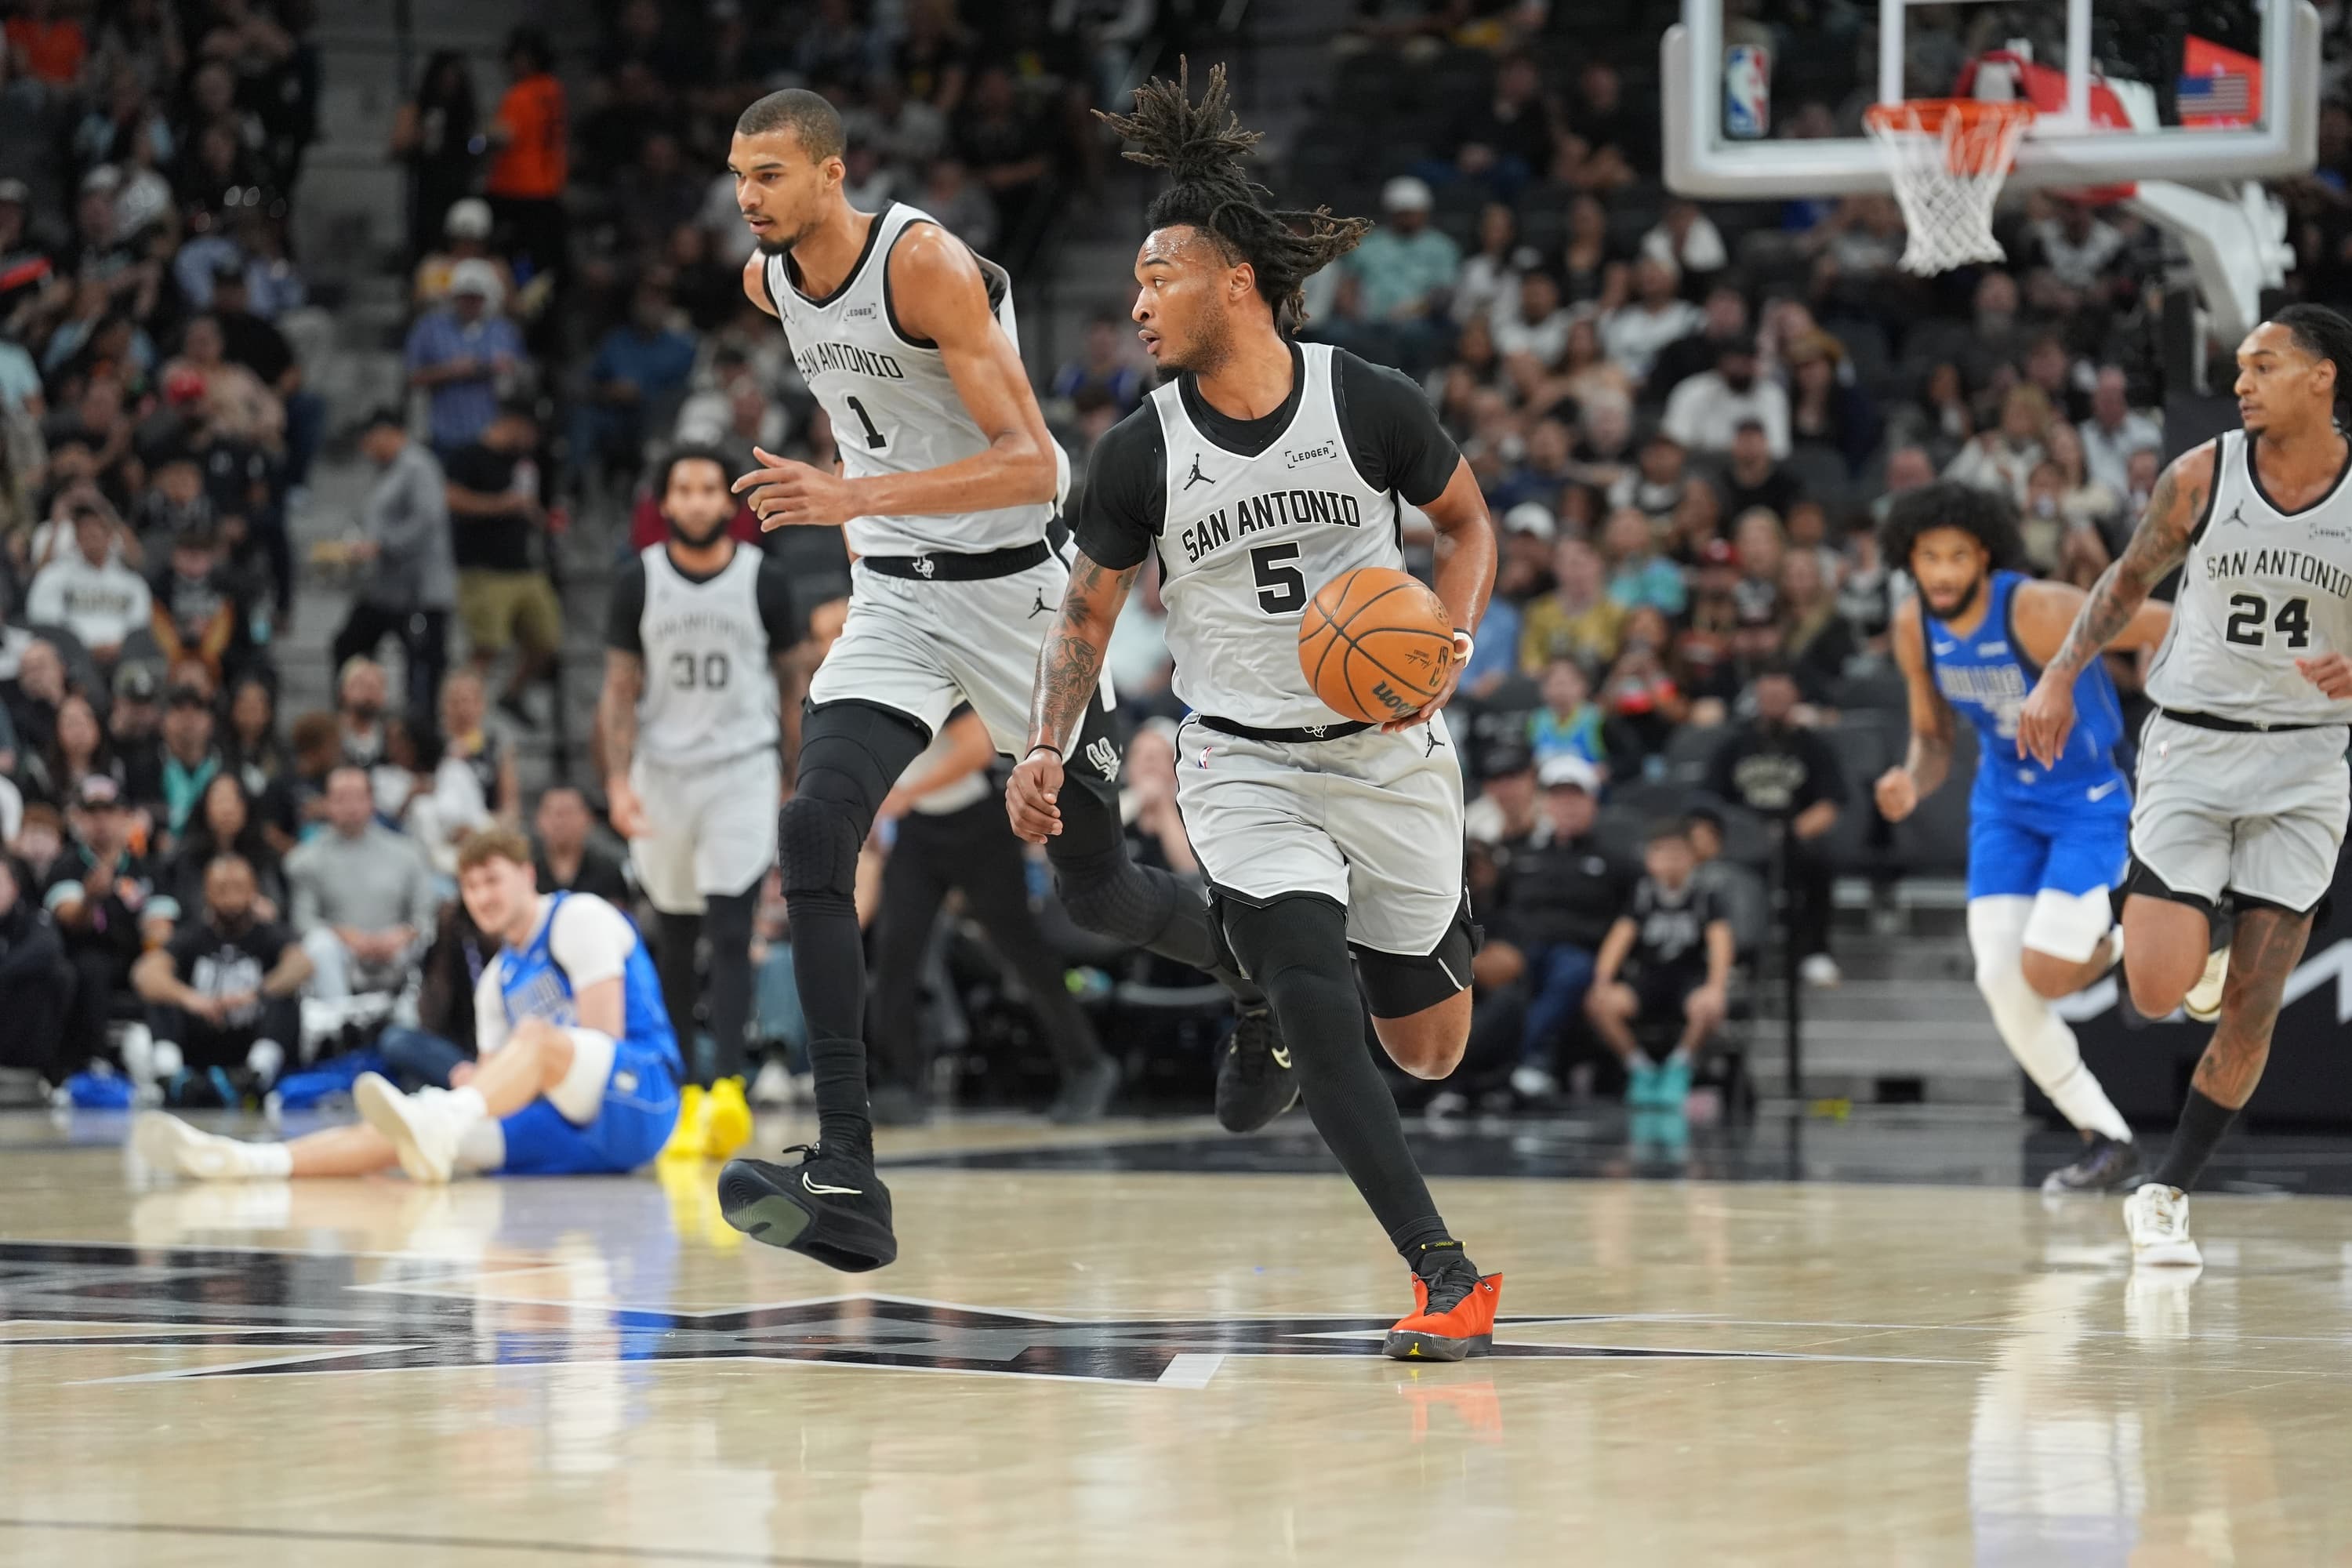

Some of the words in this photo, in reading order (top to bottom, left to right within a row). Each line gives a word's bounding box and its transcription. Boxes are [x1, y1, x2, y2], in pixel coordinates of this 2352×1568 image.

[847, 307, 872, 317] LEDGER
[816, 342, 905, 379] ANTONIO
[846, 395, 887, 449] 1
[1292, 447, 1330, 463] LEDGER
[1181, 508, 1231, 564] SAN
[1236, 489, 1361, 537] ANTONIO
[1249, 541, 1308, 615] 5
[2206, 550, 2248, 581] SAN
[2253, 549, 2352, 599] ANTONIO
[2226, 593, 2310, 648] 24
[671, 652, 731, 691] 30
